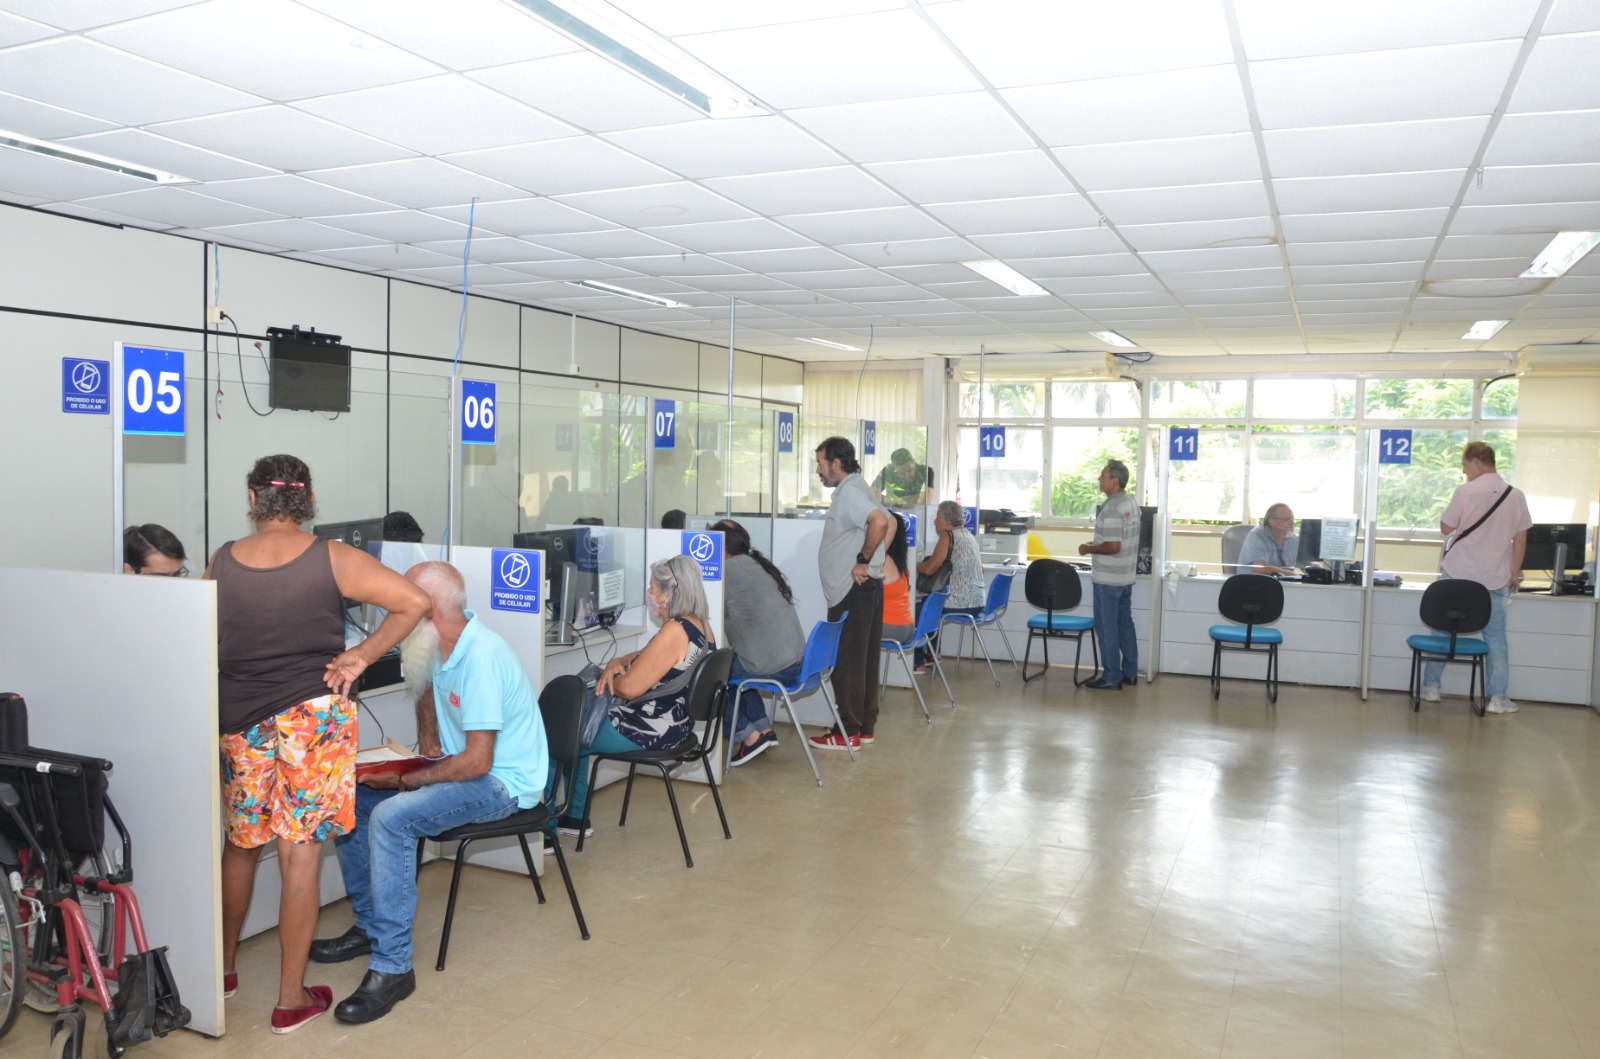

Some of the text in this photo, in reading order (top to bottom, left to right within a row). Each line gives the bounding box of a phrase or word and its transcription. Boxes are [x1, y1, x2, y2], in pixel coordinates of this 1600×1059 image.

[66, 396, 90, 404] PROIBIDO
[127, 368, 181, 415] 05
[464, 395, 494, 429] 06
[656, 411, 674, 437] 07
[780, 421, 793, 443] 08
[865, 428, 875, 447] 09
[982, 434, 1004, 451] 10
[1174, 435, 1194, 453] 11
[1382, 437, 1410, 456] 12
[494, 592, 519, 600] PROIBIDO
[506, 600, 531, 608] CELULAR
